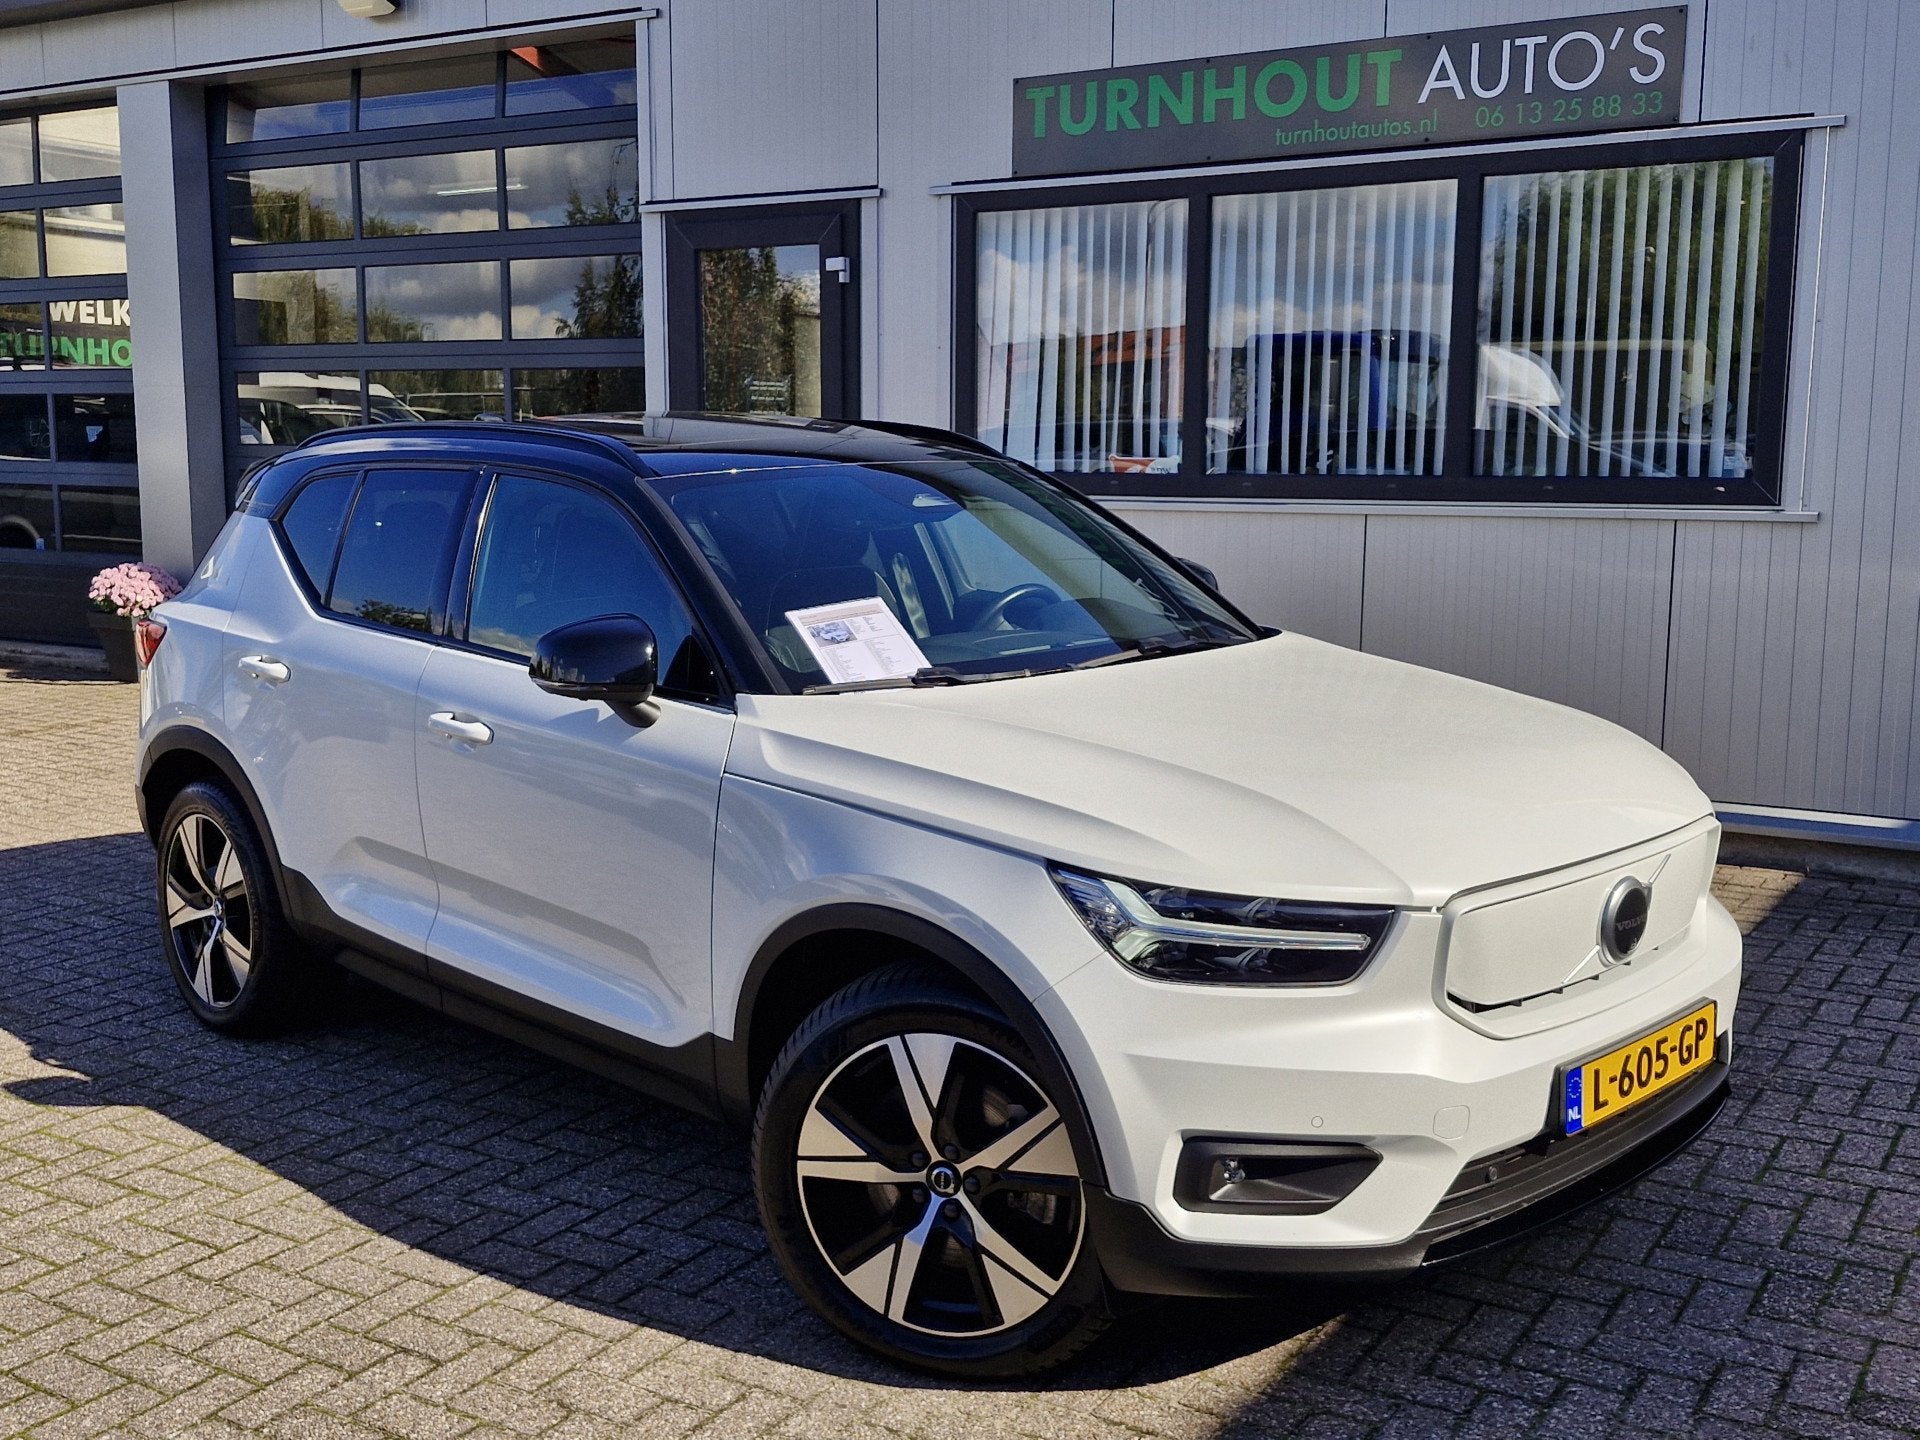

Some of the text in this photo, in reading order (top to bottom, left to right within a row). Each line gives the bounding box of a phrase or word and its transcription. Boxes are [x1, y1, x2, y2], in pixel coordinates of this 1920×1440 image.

[1026, 23, 1666, 139] TURNHOUT AUTO'S
[1275, 108, 1438, 146] turnhoutautos.nl
[1475, 91, 1663, 128] 06 13 25 88 33
[1593, 1016, 1708, 1112] L-605-GP
[1568, 1105, 1581, 1122] NL
